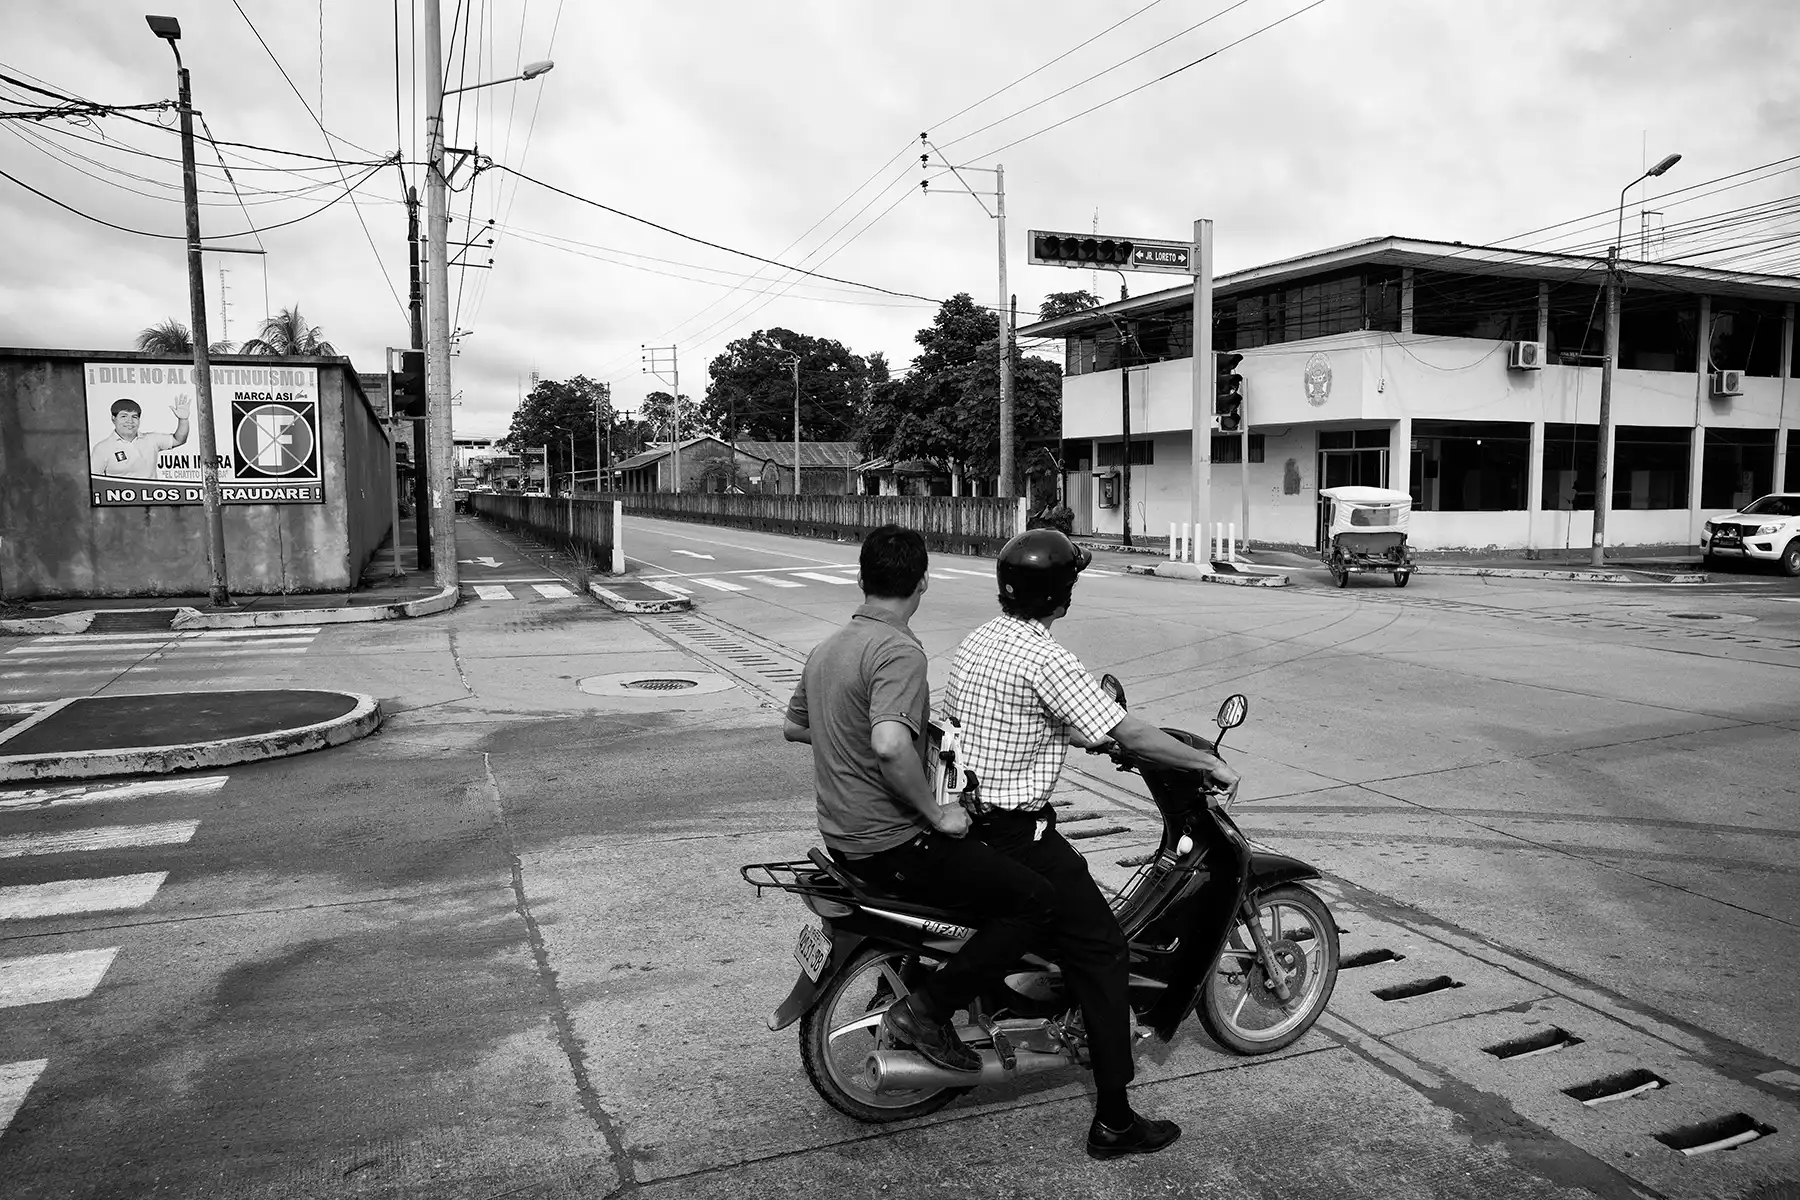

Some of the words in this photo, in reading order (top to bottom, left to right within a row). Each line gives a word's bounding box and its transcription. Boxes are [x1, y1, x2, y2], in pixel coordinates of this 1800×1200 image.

[1155, 251, 1177, 262] LORETO
[99, 367, 136, 385] DILE
[140, 368, 163, 385] NO
[167, 368, 187, 385] AL
[190, 368, 305, 387] CNTINUISMO
[235, 392, 272, 401] MARCA
[275, 393, 293, 401] ASI
[256, 415, 295, 467] F
[157, 454, 189, 469] JUAN
[193, 454, 232, 469] IRA
[106, 489, 135, 502] NO
[142, 488, 180, 501] LOS
[186, 488, 309, 501] DRAUDARE
